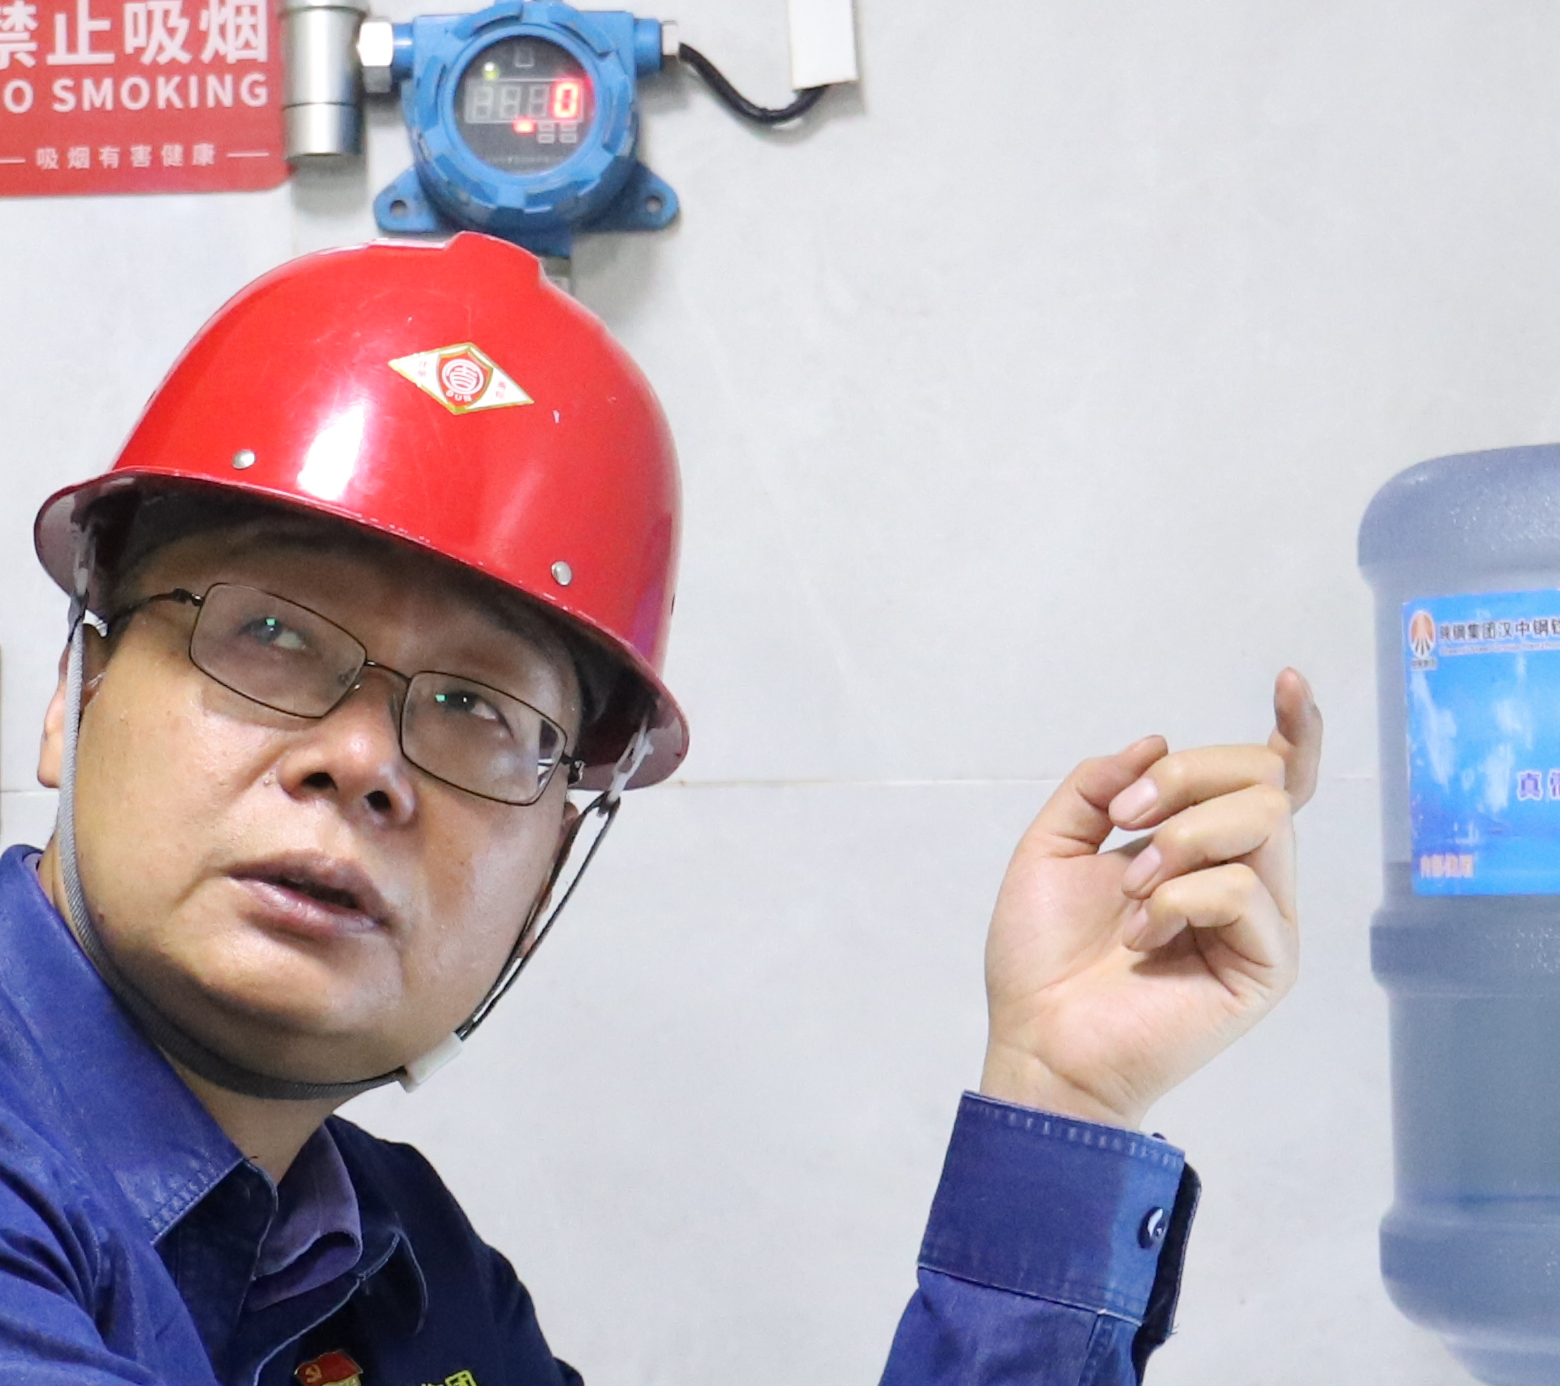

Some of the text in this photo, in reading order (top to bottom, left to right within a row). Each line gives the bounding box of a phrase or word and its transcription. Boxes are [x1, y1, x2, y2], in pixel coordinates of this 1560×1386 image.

[52, 72, 268, 112] SMOKING
[36, 143, 216, 171] 吸烟有害健康
